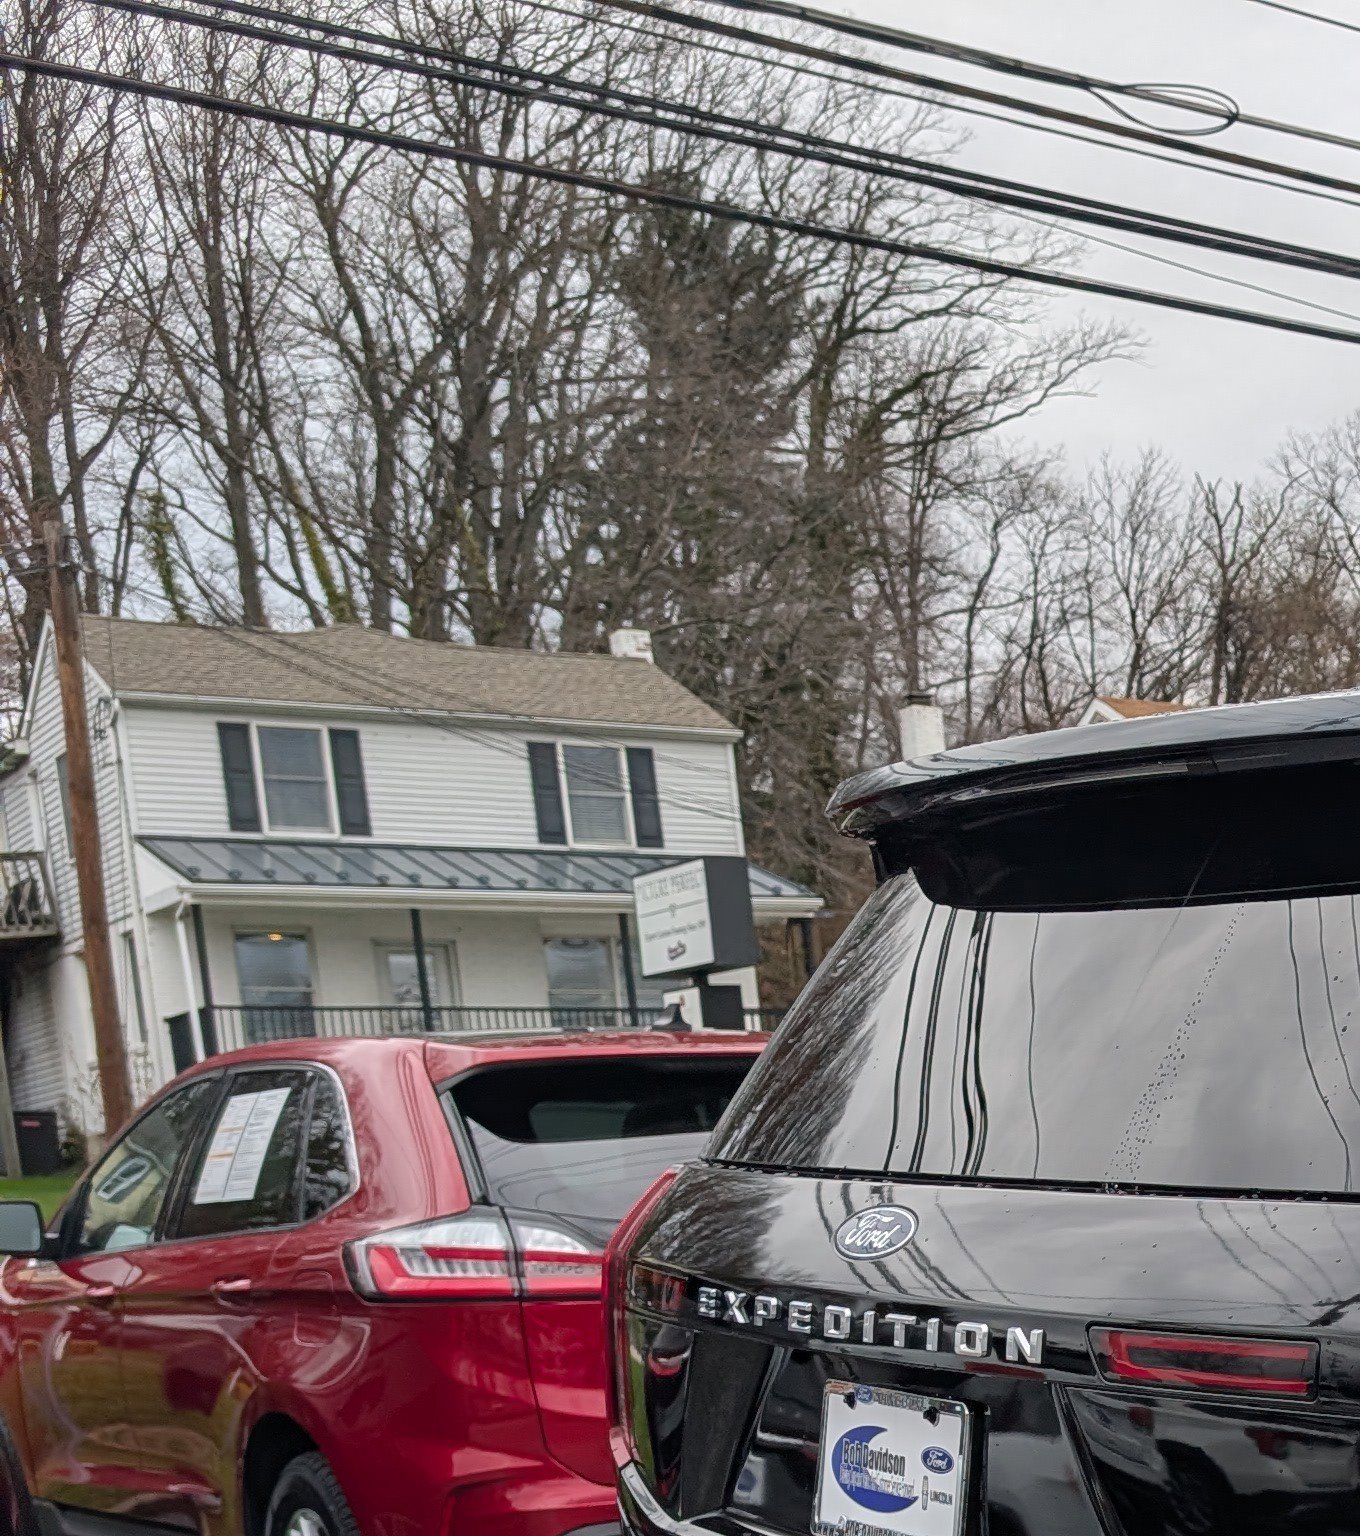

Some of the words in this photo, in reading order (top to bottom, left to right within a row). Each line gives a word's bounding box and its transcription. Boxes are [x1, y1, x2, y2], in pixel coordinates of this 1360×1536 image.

[844, 1213, 902, 1249] Ford
[698, 1287, 1044, 1365] EXPEDITION
[842, 1438, 862, 1467] Bob
[863, 1443, 906, 1477] Davidson
[927, 1450, 949, 1470] Ford
